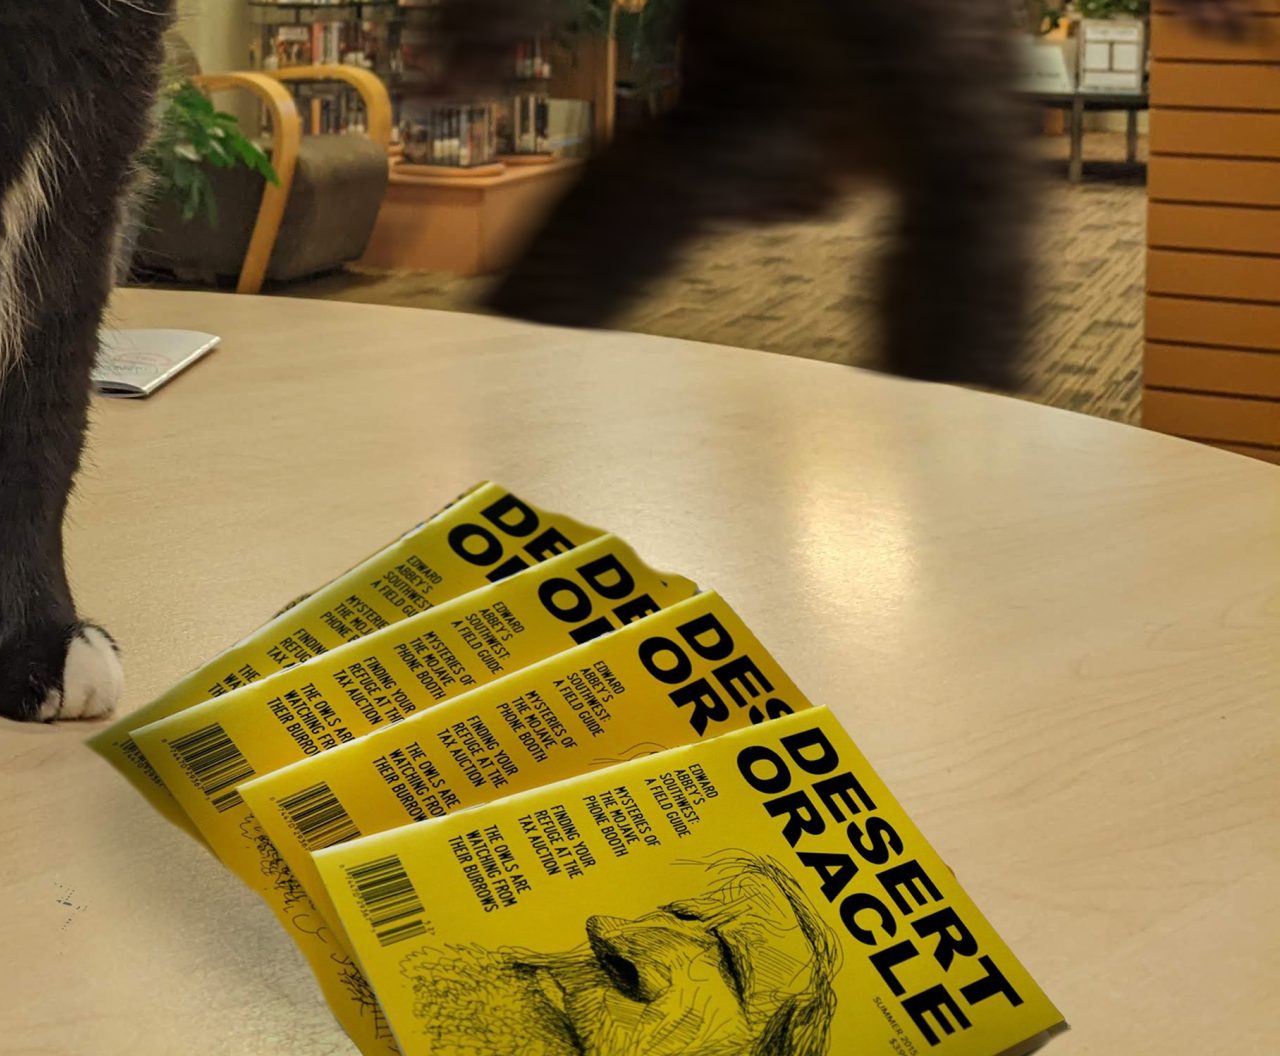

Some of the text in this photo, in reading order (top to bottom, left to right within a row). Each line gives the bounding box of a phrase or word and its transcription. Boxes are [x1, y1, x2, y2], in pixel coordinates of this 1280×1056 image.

[480, 493, 577, 563] DE
[371, 579, 383, 589] A
[377, 585, 405, 612] FIELD
[383, 571, 434, 609] SOUTHWEST
[395, 564, 433, 594] ABBEY'S
[406, 555, 443, 585] EDWARD
[574, 552, 661, 622] DE
[321, 612, 352, 638] PHONE
[334, 603, 374, 637] THE MOJ
[346, 595, 391, 628] MYSTERIE
[479, 608, 513, 641] ABBEY'S
[492, 601, 525, 634] EDWARD
[238, 664, 261, 682] THE
[267, 646, 289, 664] TAX
[280, 638, 313, 664] REFUG
[394, 643, 447, 700] PHONE BOOTH
[409, 637, 456, 687] THE MOJAVE
[423, 631, 477, 686] MYSTERIES OF
[451, 620, 504, 675] A FIELD GUIDE
[676, 612, 798, 726] DES
[300, 683, 322, 702] THE
[314, 701, 341, 727] OWLS
[332, 669, 354, 688] TAX
[346, 688, 383, 725] AUCTION
[348, 663, 382, 696] REFUGE
[374, 695, 391, 708] AT
[364, 656, 416, 714] FINDING YOUR
[567, 672, 612, 723] SOUTHWEST:
[580, 668, 614, 703] ABBEY'S
[593, 661, 625, 695] EDWARD
[637, 635, 731, 738] OR
[267, 697, 321, 756] THEIR BURRO
[284, 689, 326, 734] WATCHING
[496, 703, 548, 763] PHONE BOOTH
[512, 696, 558, 750] THE MOJAVE
[525, 690, 578, 749] MYSTERIES OF
[553, 679, 605, 738] A FIELD GUIDE
[388, 748, 430, 796] WATCHING
[436, 728, 487, 788] TAX AUCTION
[452, 722, 509, 789] REFUGE AT THE
[467, 715, 519, 777] FINDING YOUR
[372, 756, 428, 822] THEIR BURROW
[405, 741, 461, 809] THE OWLS ARE
[659, 772, 700, 824] SOUTHWEST:
[674, 769, 706, 806] ABBEY'S
[688, 763, 719, 799] EDWARD
[550, 804, 596, 868] FINDING YOUR
[582, 795, 629, 857] PHONE BOOTH
[599, 790, 640, 845] THE MOJAVE
[614, 786, 662, 847] MYSTERIES OF
[644, 778, 691, 839] A FIELD GUIDE
[466, 829, 517, 907] WATCHING FROM
[484, 824, 532, 895] THE OWLS ARE
[518, 814, 561, 876] TAX AUCTION
[534, 809, 584, 879] REFUGE AT THE
[779, 726, 1025, 1010] DESERT
[448, 835, 499, 913] THEIR BURROWS
[736, 744, 973, 1048] ORACLE
[873, 997, 903, 1035] SUMMER
